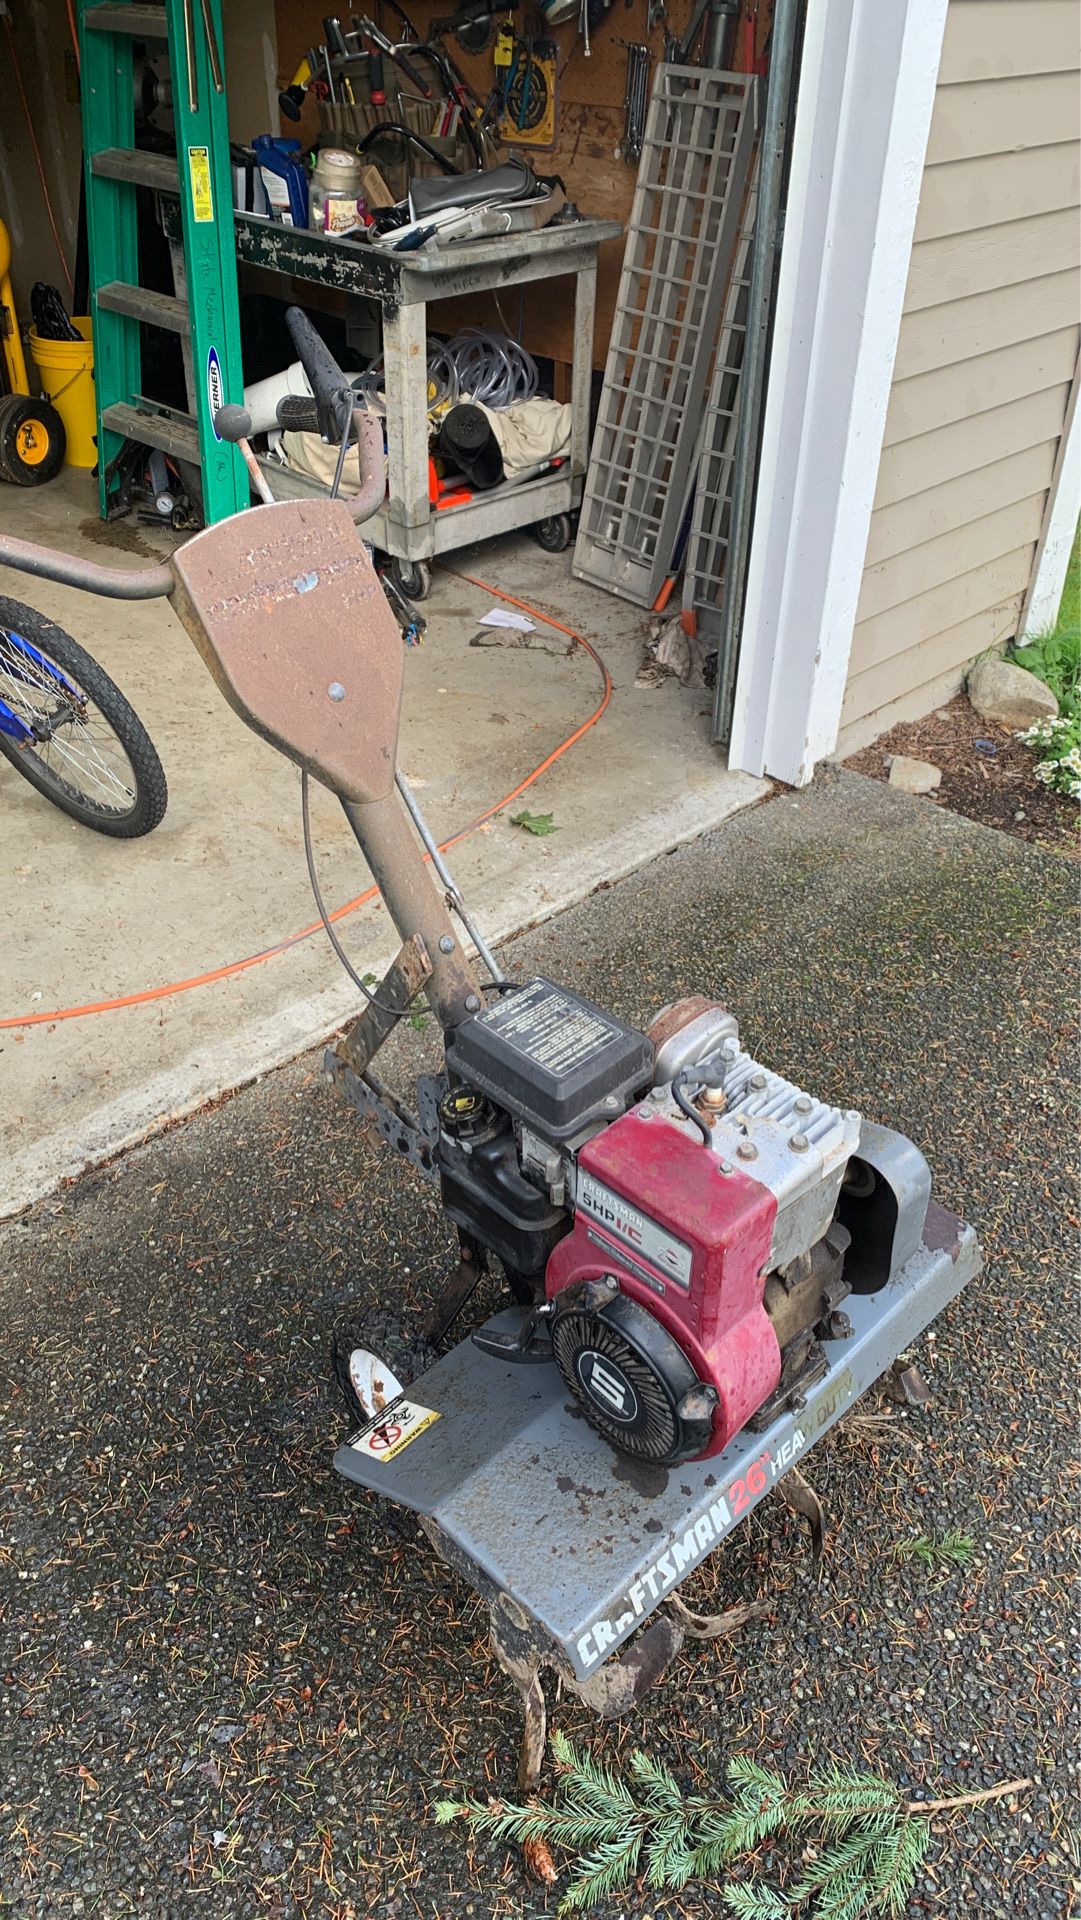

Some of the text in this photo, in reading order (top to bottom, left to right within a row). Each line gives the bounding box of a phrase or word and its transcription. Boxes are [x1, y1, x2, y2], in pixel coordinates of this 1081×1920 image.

[210, 366, 220, 414] ERNER
[583, 1178, 644, 1230] CRAFTSMAN
[389, 1426, 422, 1456] WARNING
